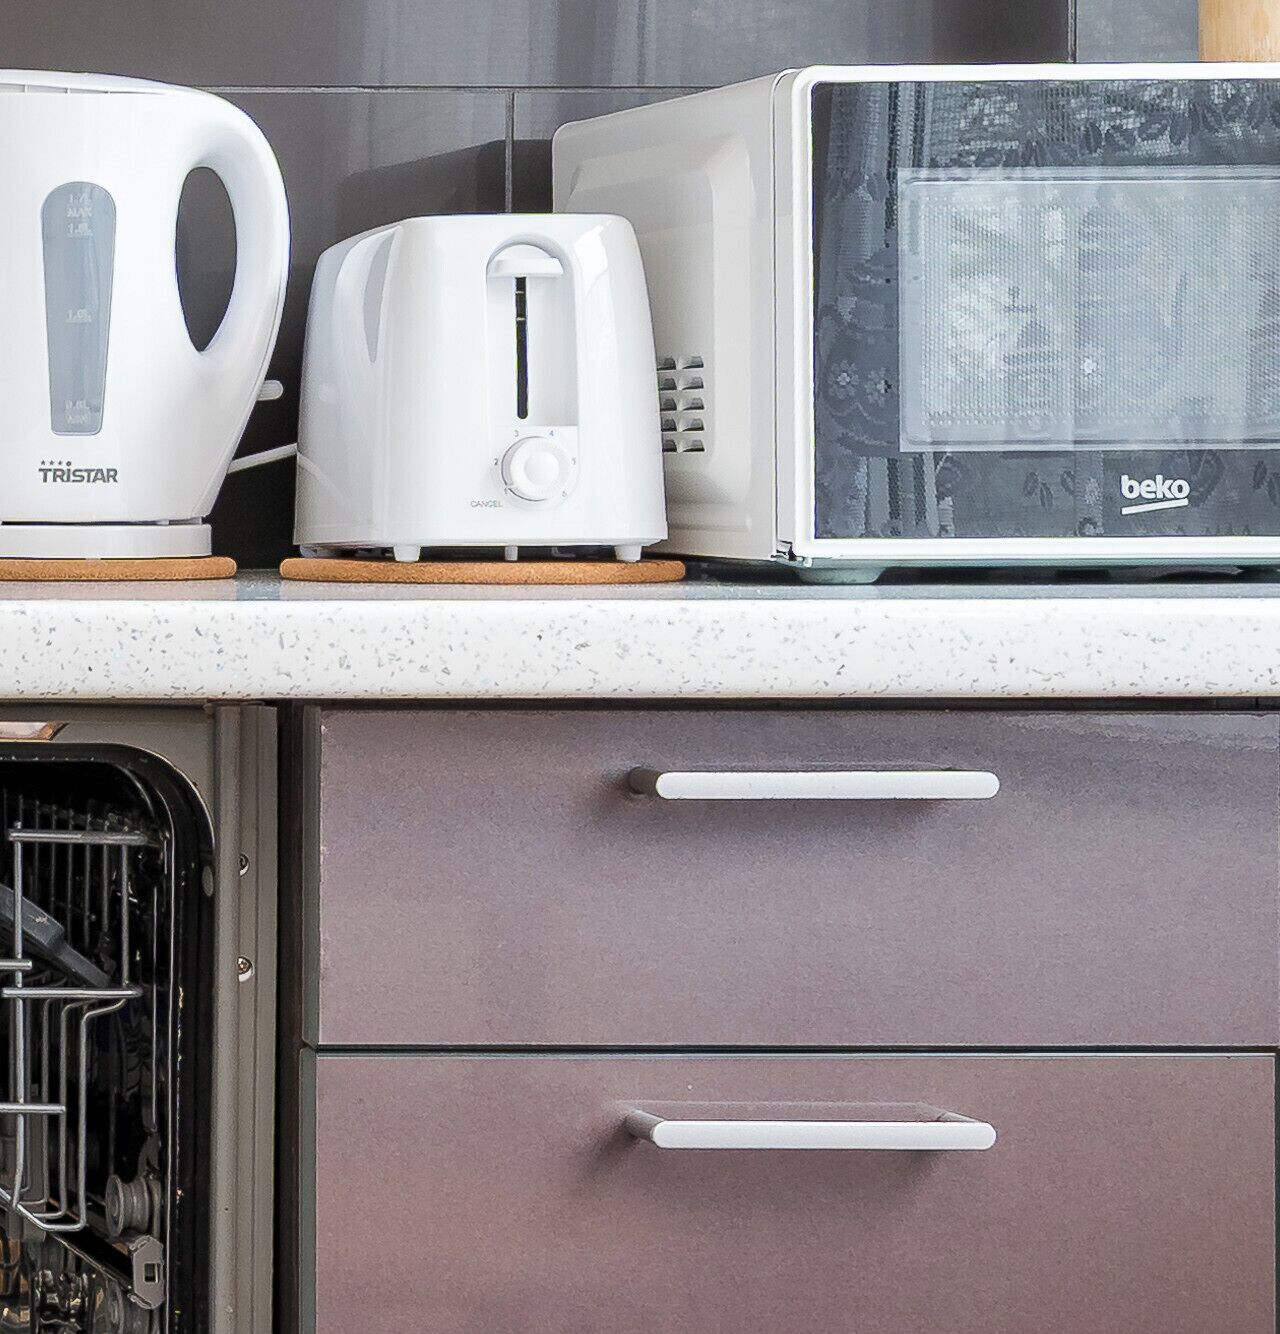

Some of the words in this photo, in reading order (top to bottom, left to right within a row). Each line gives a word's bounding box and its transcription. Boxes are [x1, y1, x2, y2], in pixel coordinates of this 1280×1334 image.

[513, 429, 520, 438] 3
[548, 429, 555, 437] 4
[493, 457, 500, 467] 2
[1120, 474, 1191, 500] beko
[469, 499, 504, 508] CANCEL
